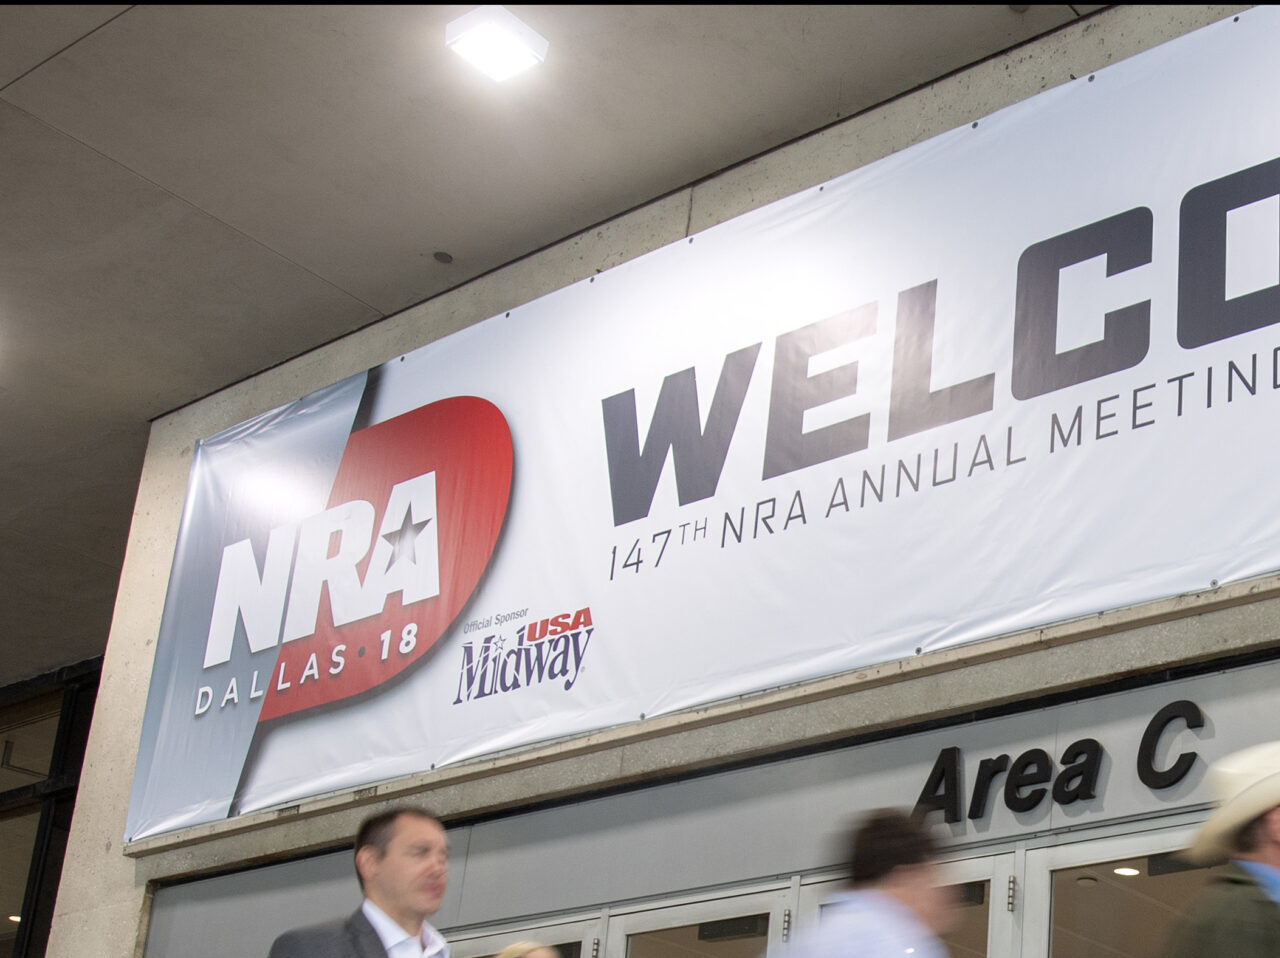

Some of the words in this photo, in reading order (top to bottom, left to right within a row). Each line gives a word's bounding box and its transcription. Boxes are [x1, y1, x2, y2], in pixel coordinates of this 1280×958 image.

[610, 516, 708, 580] 147TH
[721, 490, 807, 548] NRA
[825, 426, 1027, 518] ANNUAL
[203, 470, 440, 669] NRA
[463, 615, 493, 635] Official
[494, 607, 529, 625] Sponsor
[526, 606, 593, 642] USA
[194, 644, 346, 717] DALLAS
[379, 623, 418, 661] 18
[908, 738, 1104, 825] Area
[1136, 699, 1205, 790] C
